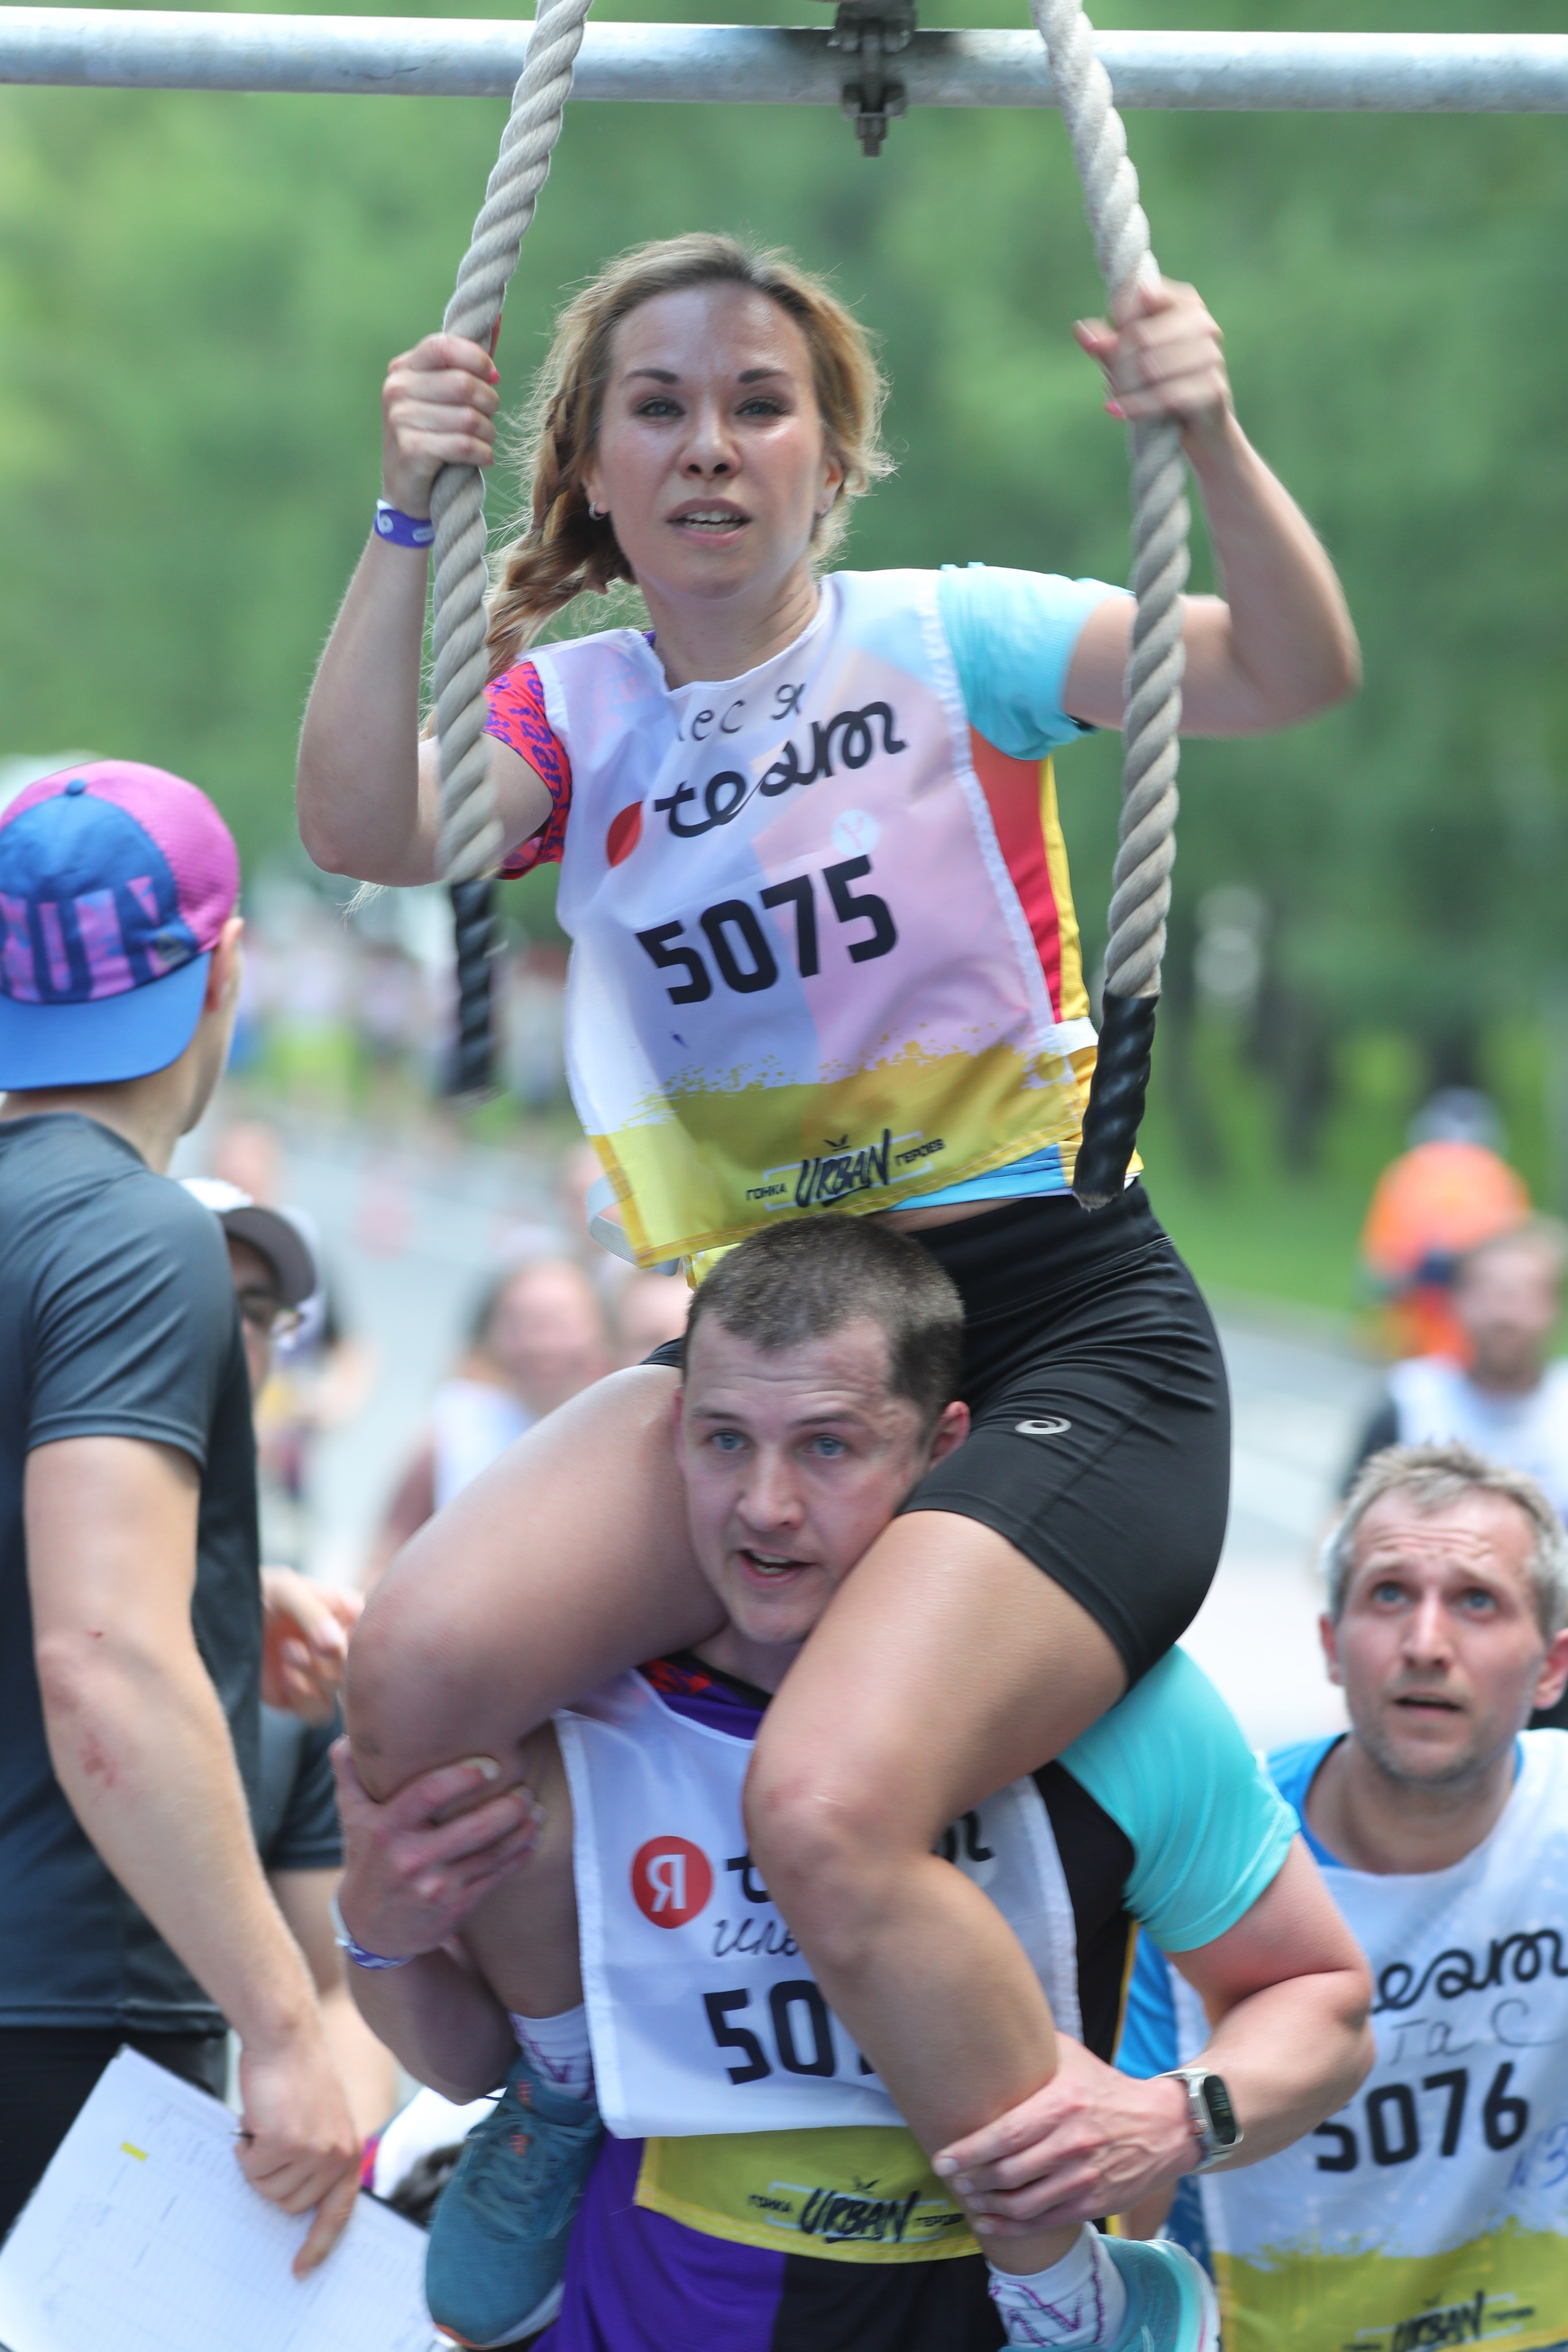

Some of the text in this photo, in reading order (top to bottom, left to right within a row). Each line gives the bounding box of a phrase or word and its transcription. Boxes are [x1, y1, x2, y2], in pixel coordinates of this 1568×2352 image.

[652, 700, 908, 839] team
[634, 855, 899, 1005] 5075
[745, 1128, 946, 1208] ГОНКА URBAN ГЕРОЕВ
[1370, 1928, 1568, 2015] eam
[701, 1979, 876, 2086] 50
[799, 2187, 921, 2244] URBAN
